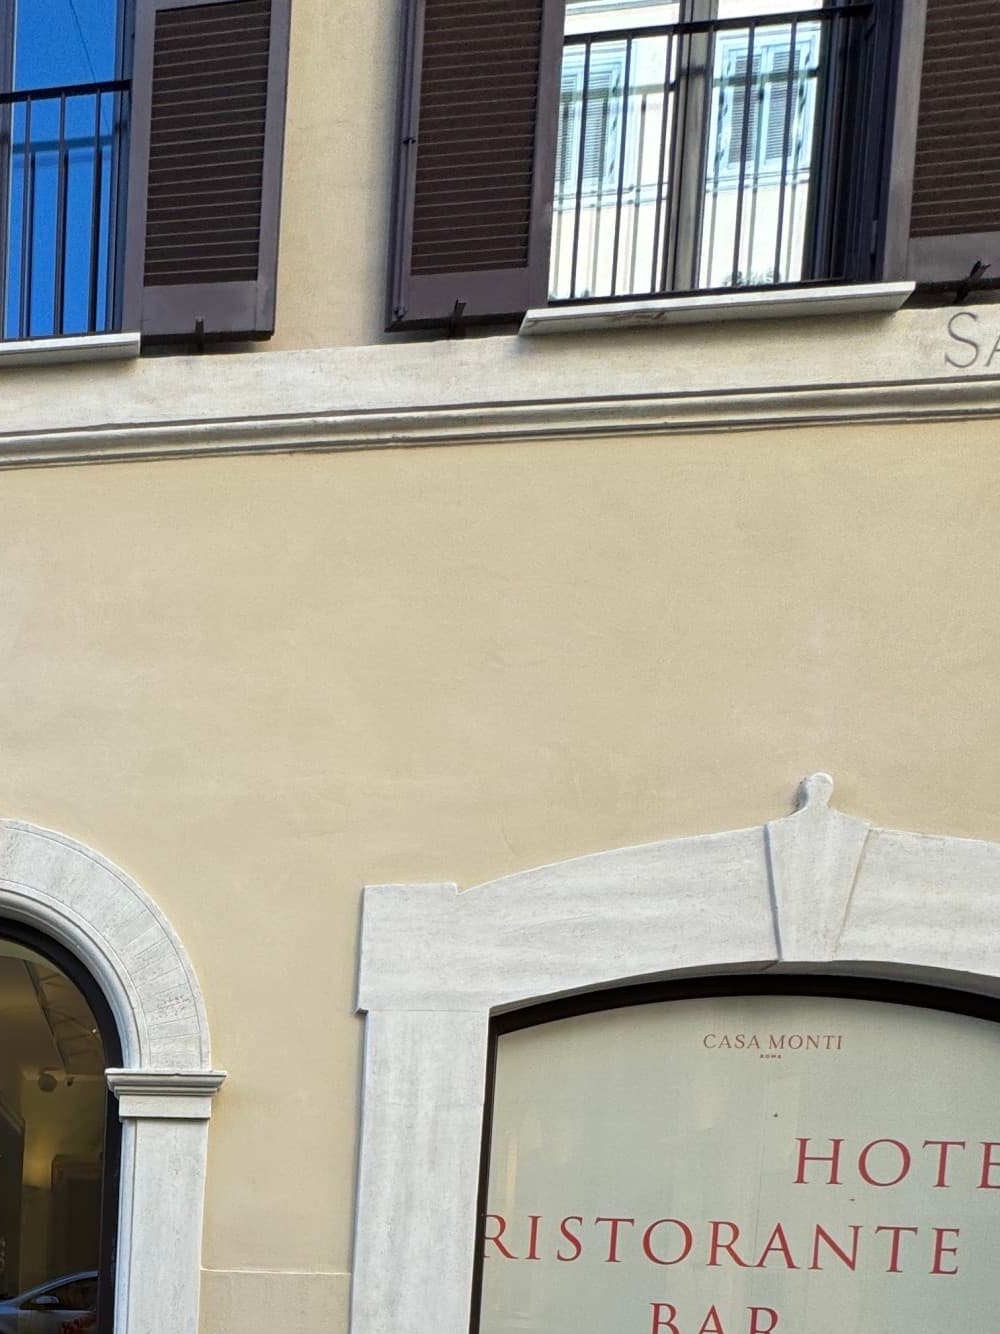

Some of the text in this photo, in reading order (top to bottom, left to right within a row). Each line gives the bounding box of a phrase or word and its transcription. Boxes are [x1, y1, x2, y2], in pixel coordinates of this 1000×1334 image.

[703, 1034, 842, 1050] CASA MONTI
[793, 1137, 1000, 1190] HOTE
[481, 1213, 960, 1275] RISTORANTE
